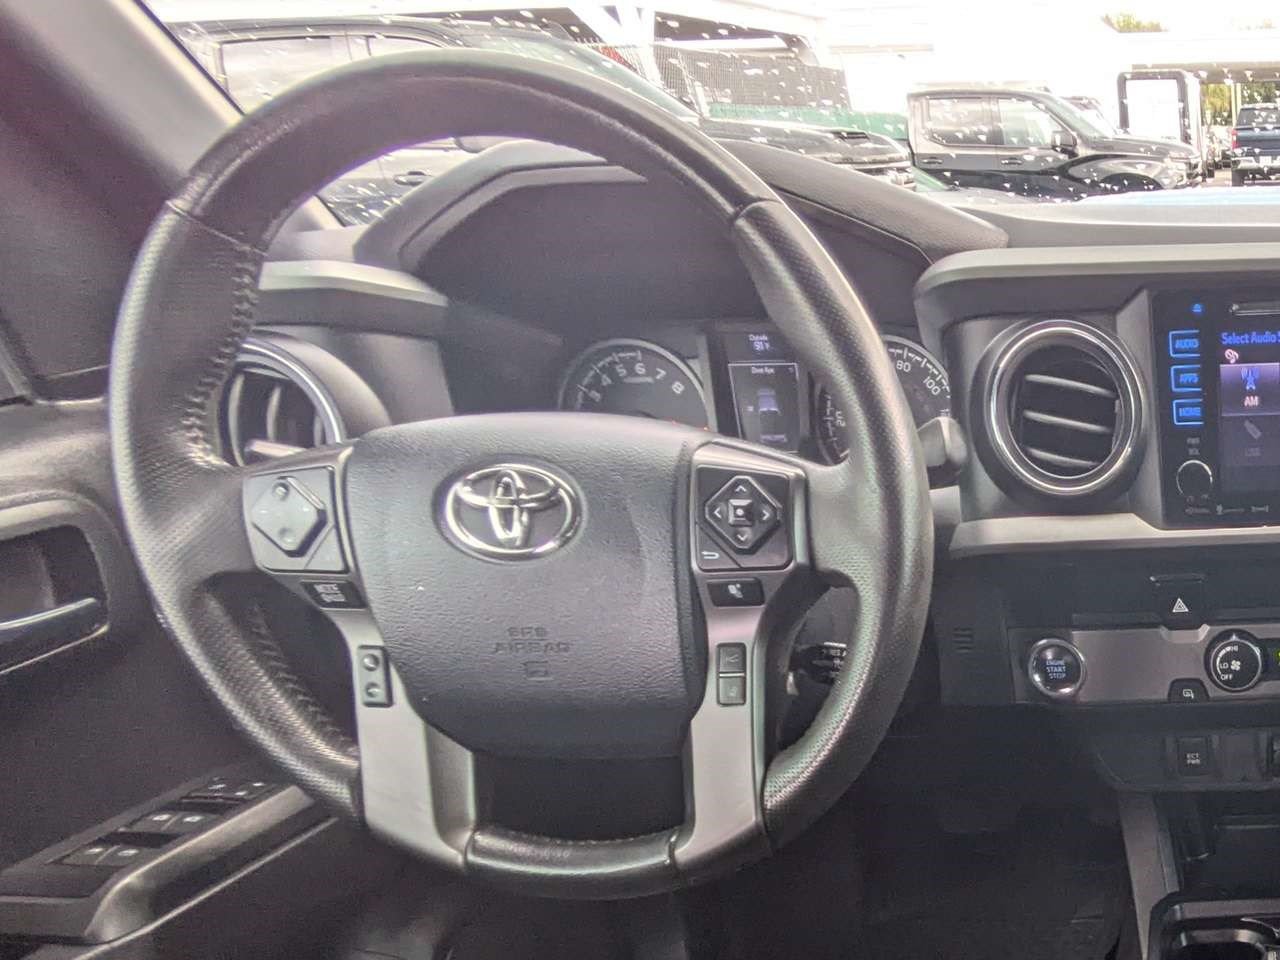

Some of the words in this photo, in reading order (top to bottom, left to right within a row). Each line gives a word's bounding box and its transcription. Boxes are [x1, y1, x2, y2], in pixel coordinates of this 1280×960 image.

[1221, 331, 1249, 345] Select
[1250, 330, 1277, 344] Audio
[615, 364, 628, 377] 5
[634, 362, 647, 375] 6
[895, 360, 911, 373] 80
[655, 368, 667, 380] 7
[671, 380, 686, 394] 8
[922, 376, 941, 396] 100
[1243, 396, 1260, 407] AM
